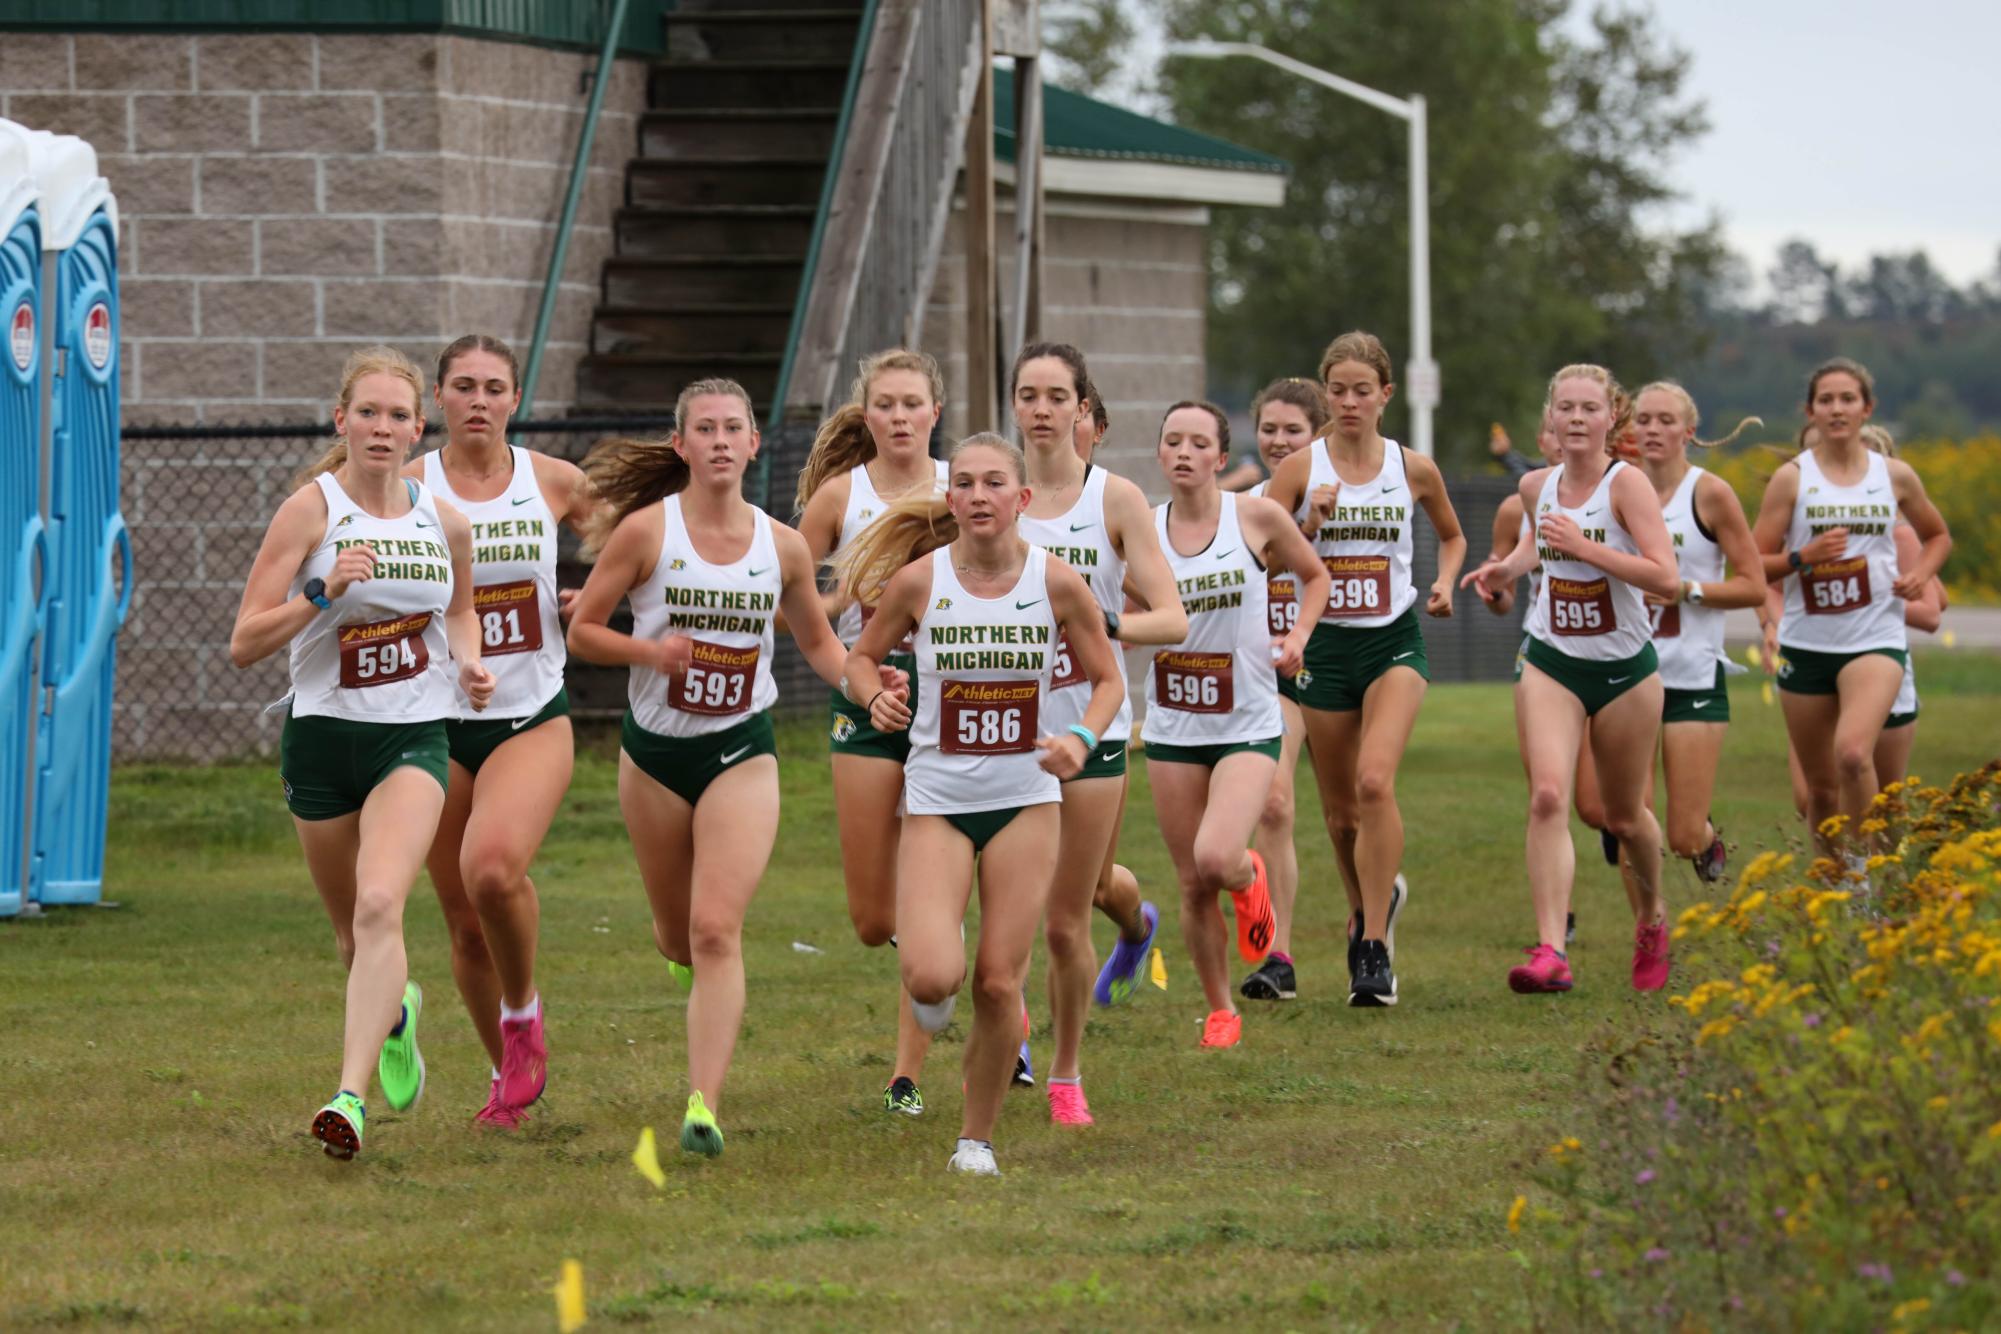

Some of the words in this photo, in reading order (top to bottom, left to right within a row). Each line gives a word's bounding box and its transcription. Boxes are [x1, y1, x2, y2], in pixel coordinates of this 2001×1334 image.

[1807, 504, 1891, 519] NORTHERN
[472, 520, 544, 540] THERN
[1319, 527, 1400, 543] MICHIGAN
[373, 562, 448, 585] CHIGAN
[665, 586, 774, 611] NORTHERN
[1329, 579, 1379, 609] 598
[1812, 577, 1860, 608] 584
[668, 612, 766, 636] MICHIGAN
[1554, 600, 1603, 629] 595
[929, 625, 1050, 645] NORTHERN
[357, 637, 417, 678] 594
[935, 651, 1044, 672] MICHIGAN
[683, 667, 746, 707] 593
[1167, 673, 1219, 706] 596
[958, 708, 1021, 745] 586
